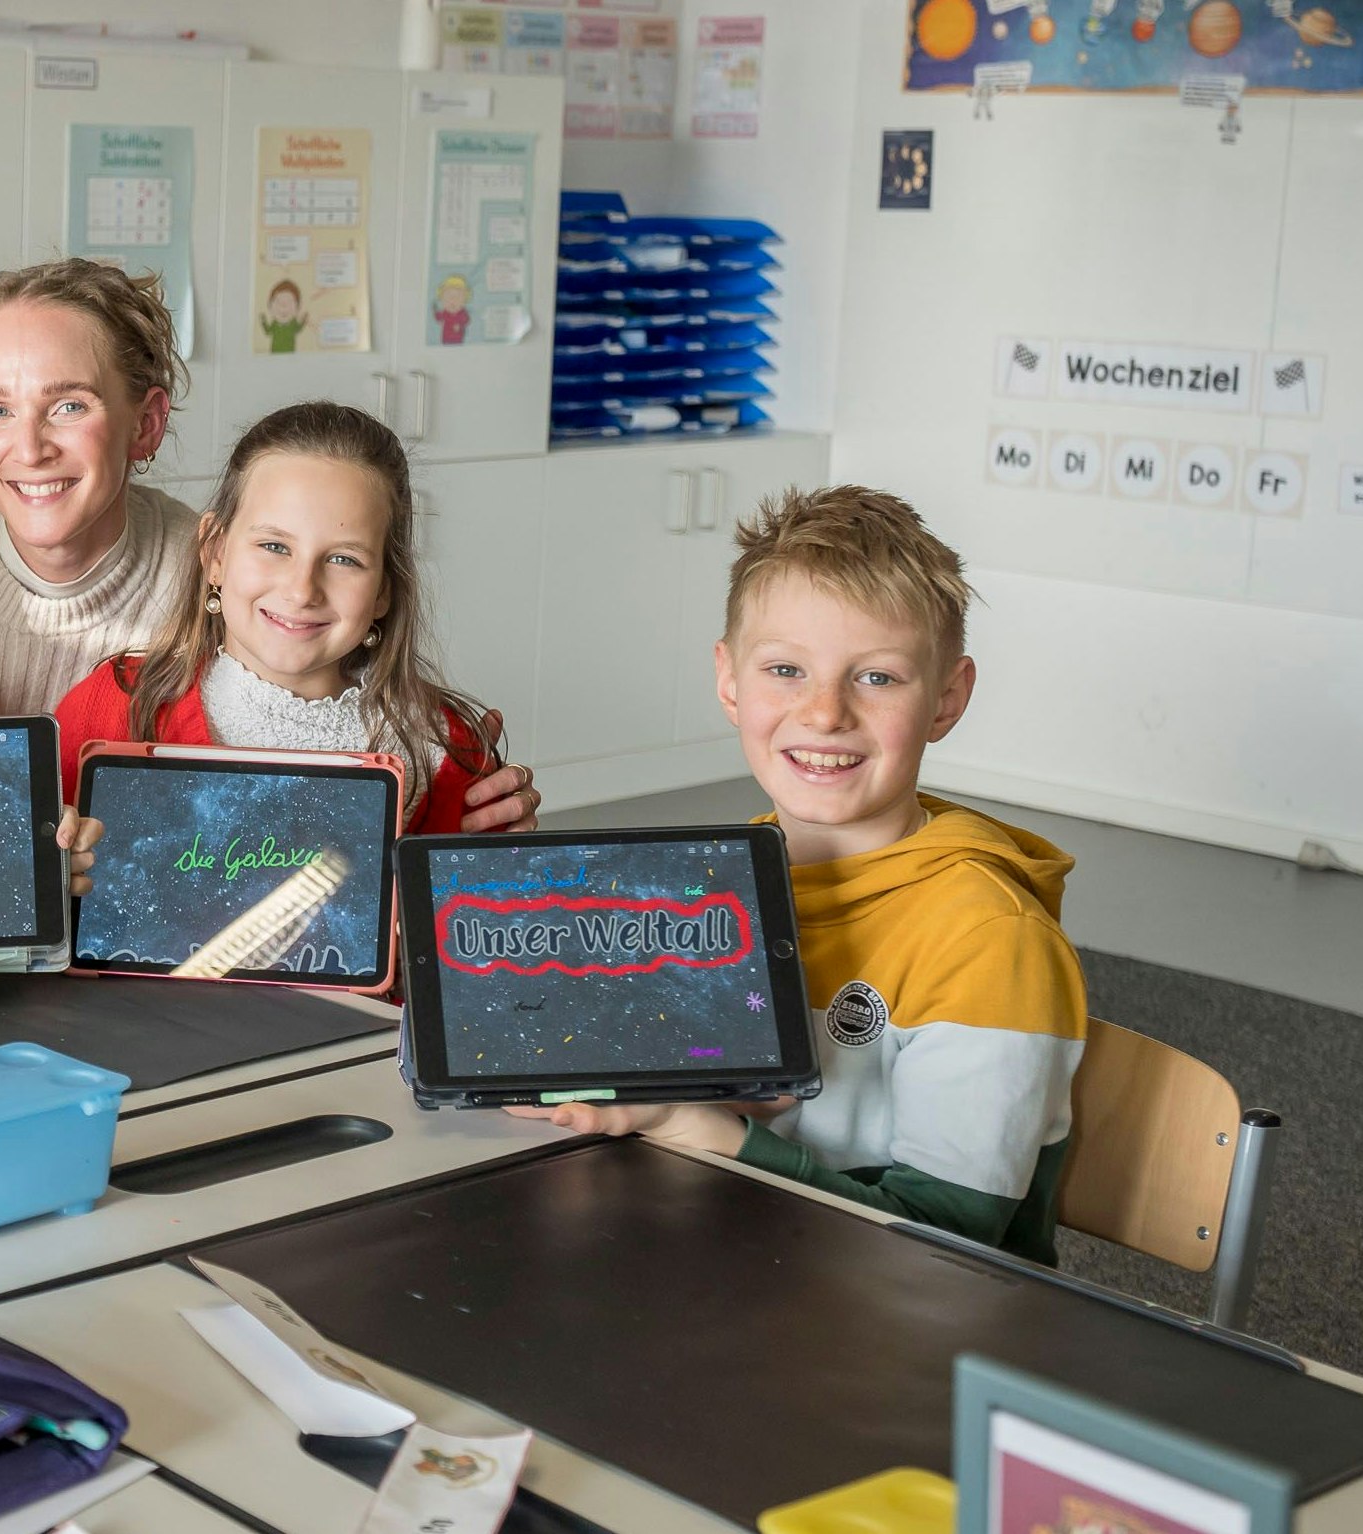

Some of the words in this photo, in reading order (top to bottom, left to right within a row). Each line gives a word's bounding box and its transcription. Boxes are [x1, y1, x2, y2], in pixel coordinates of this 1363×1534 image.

[1066, 354, 1239, 395] Wochenziel
[995, 444, 1031, 468] Mo
[1064, 450, 1086, 474] Di
[1124, 456, 1154, 482] Mi
[1188, 463, 1221, 488] Do
[1258, 471, 1288, 497] Fr
[174, 833, 216, 872] die
[453, 917, 570, 958] Unser
[577, 907, 731, 954] Weltall
[867, 991, 886, 1018] BRAND
